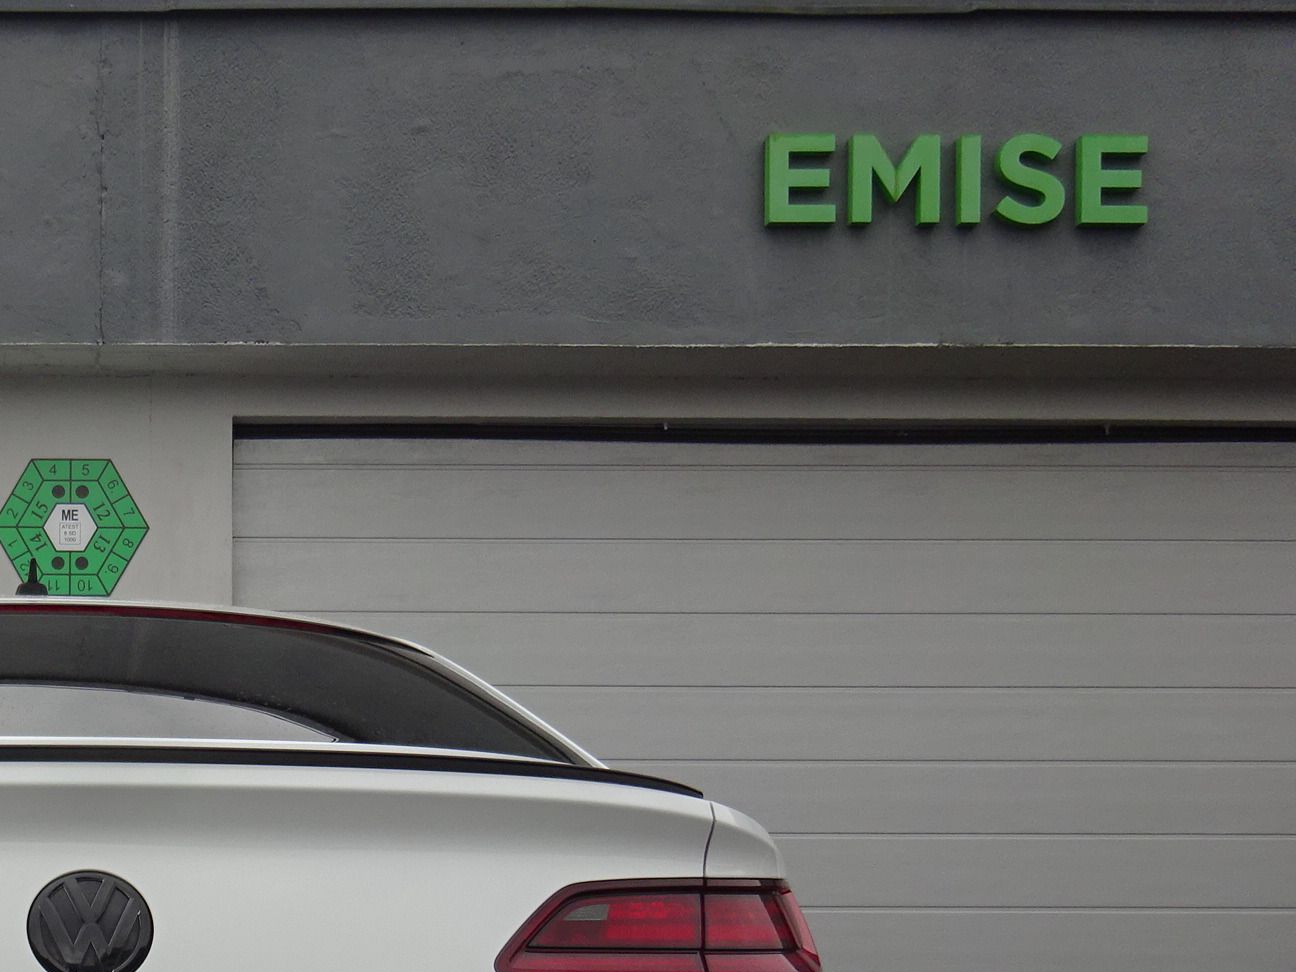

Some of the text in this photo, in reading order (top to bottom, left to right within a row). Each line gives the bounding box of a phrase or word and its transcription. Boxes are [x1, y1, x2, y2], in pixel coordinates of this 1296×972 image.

[764, 133, 1150, 226] EMISE
[48, 464, 57, 476] 4
[81, 464, 90, 476] 5
[22, 480, 34, 491] 3
[6, 508, 19, 519] 2
[31, 501, 49, 520] 15
[61, 509, 79, 521] ME
[93, 503, 111, 521] 12
[123, 507, 136, 518] 7
[8, 538, 18, 548] 1
[29, 531, 48, 551] 14
[93, 534, 111, 553] 13
[122, 538, 134, 549] 8
[77, 580, 93, 591] 10
